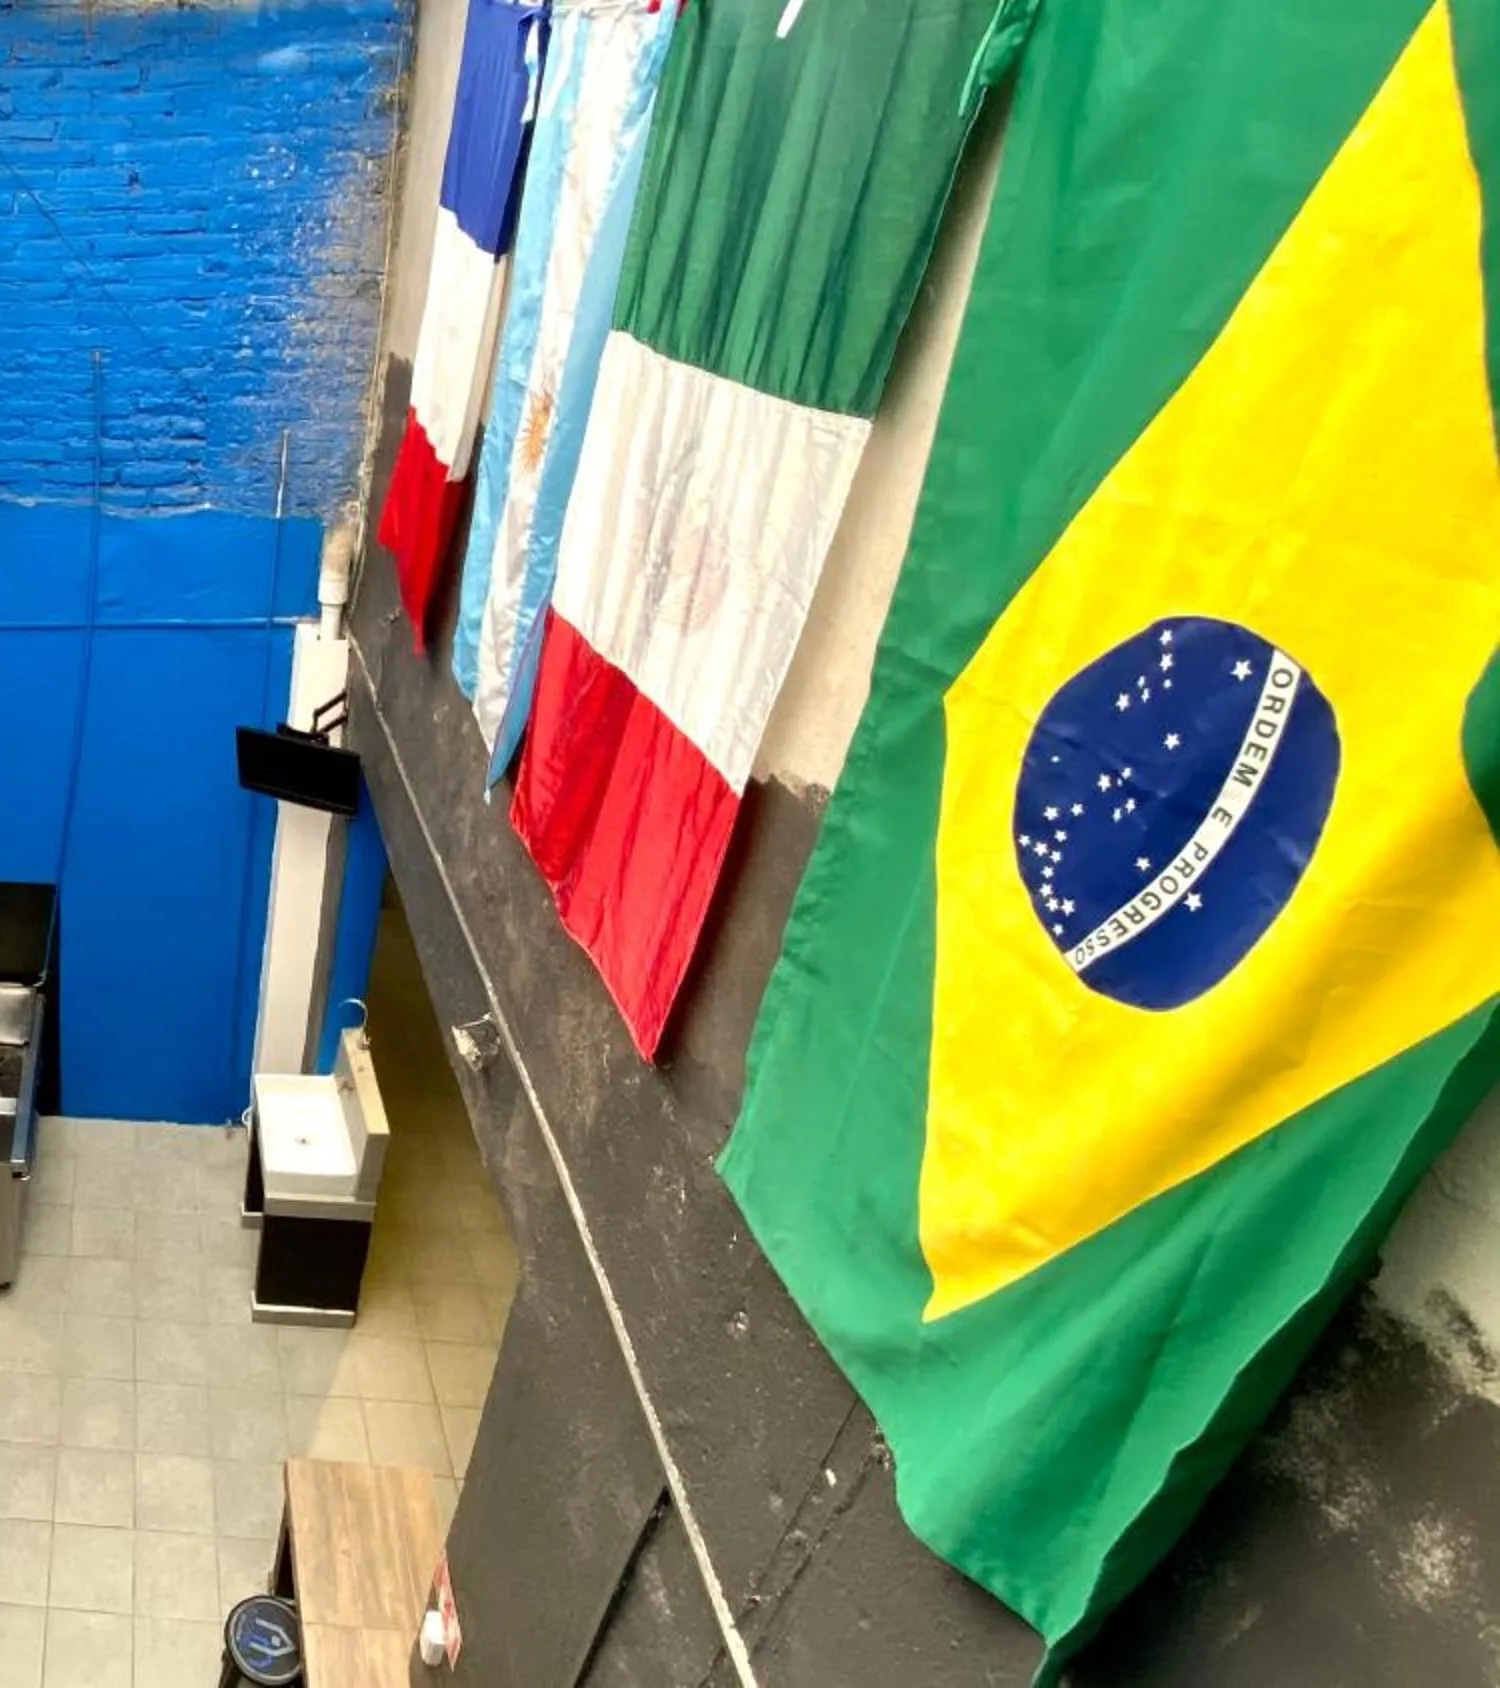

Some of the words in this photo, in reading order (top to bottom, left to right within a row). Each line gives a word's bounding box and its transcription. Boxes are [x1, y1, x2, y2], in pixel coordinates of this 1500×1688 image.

[1232, 667, 1293, 787] ORDEM
[1211, 806, 1233, 827] E
[1074, 842, 1208, 965] PROGRESSO
